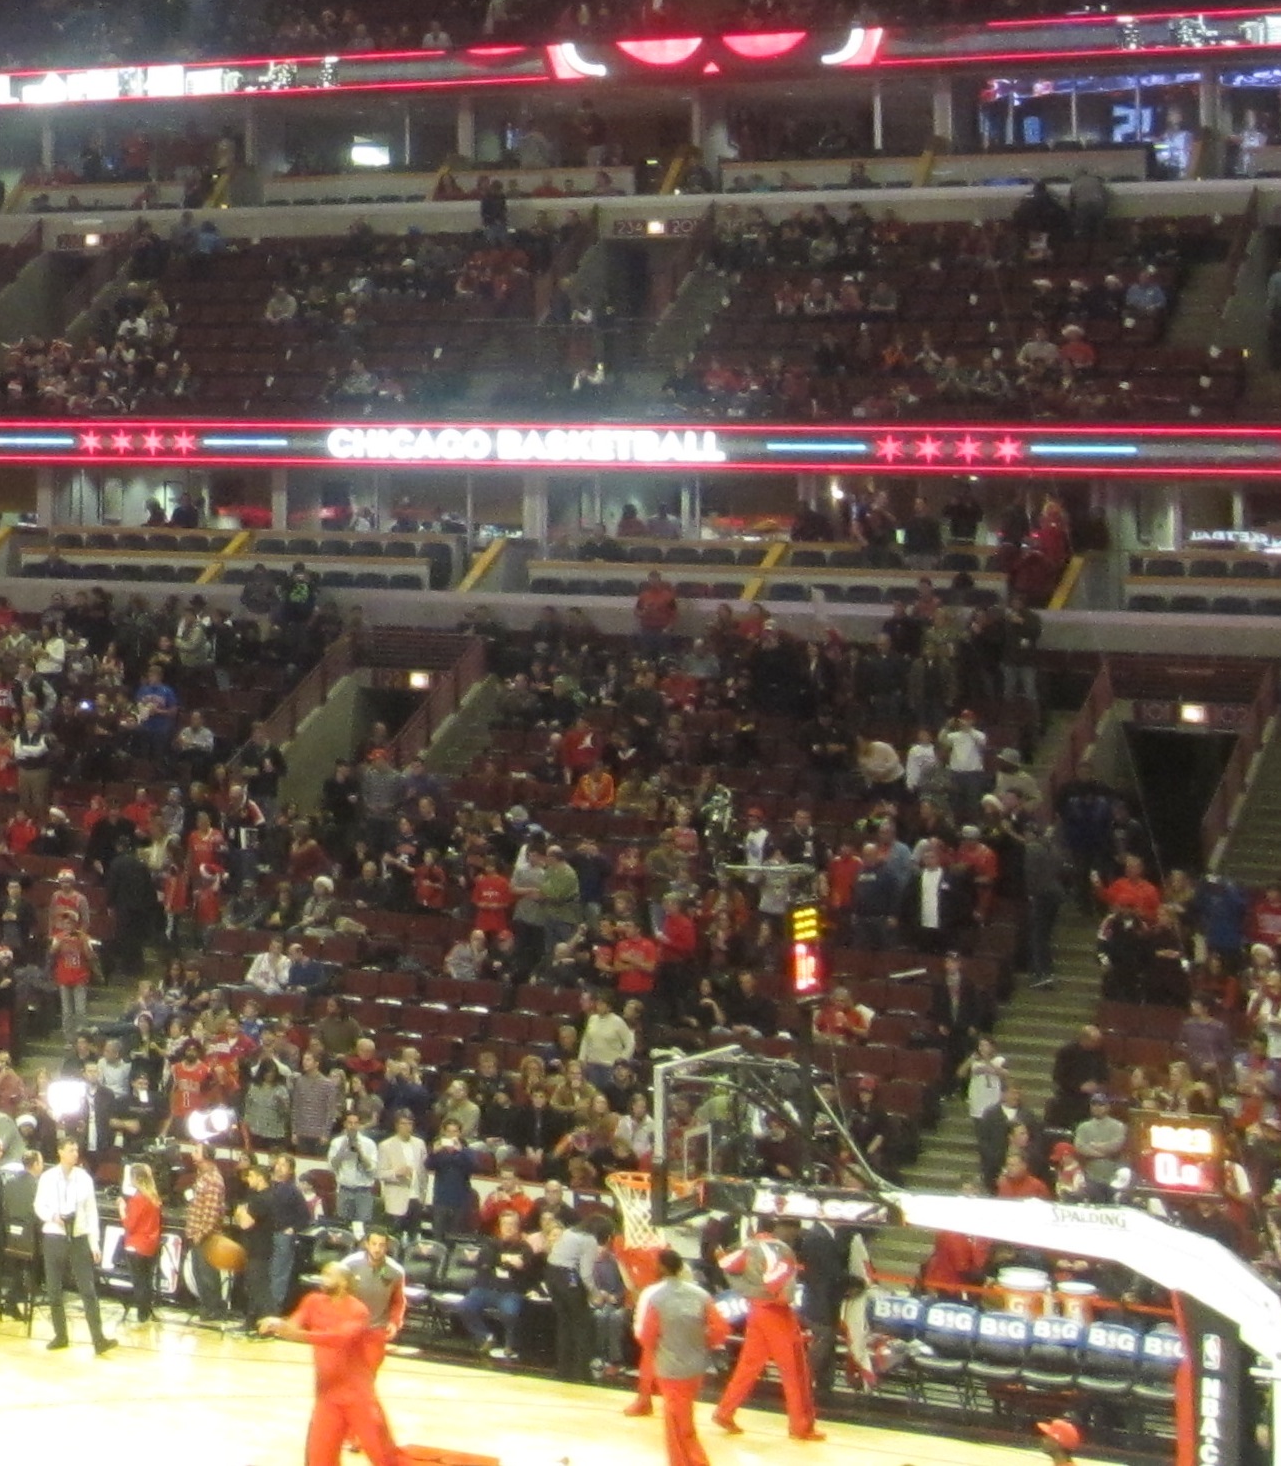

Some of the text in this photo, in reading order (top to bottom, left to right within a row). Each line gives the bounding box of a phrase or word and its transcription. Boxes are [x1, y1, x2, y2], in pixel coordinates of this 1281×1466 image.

[327, 428, 727, 463] CHICAGO BASKETBALL
[1051, 1207, 1127, 1229] SPALDING
[874, 1300, 918, 1320] BIG
[927, 1308, 973, 1331] BIG
[980, 1317, 1026, 1340] BIG
[1033, 1319, 1079, 1340] BIG
[1088, 1327, 1136, 1352] BIG
